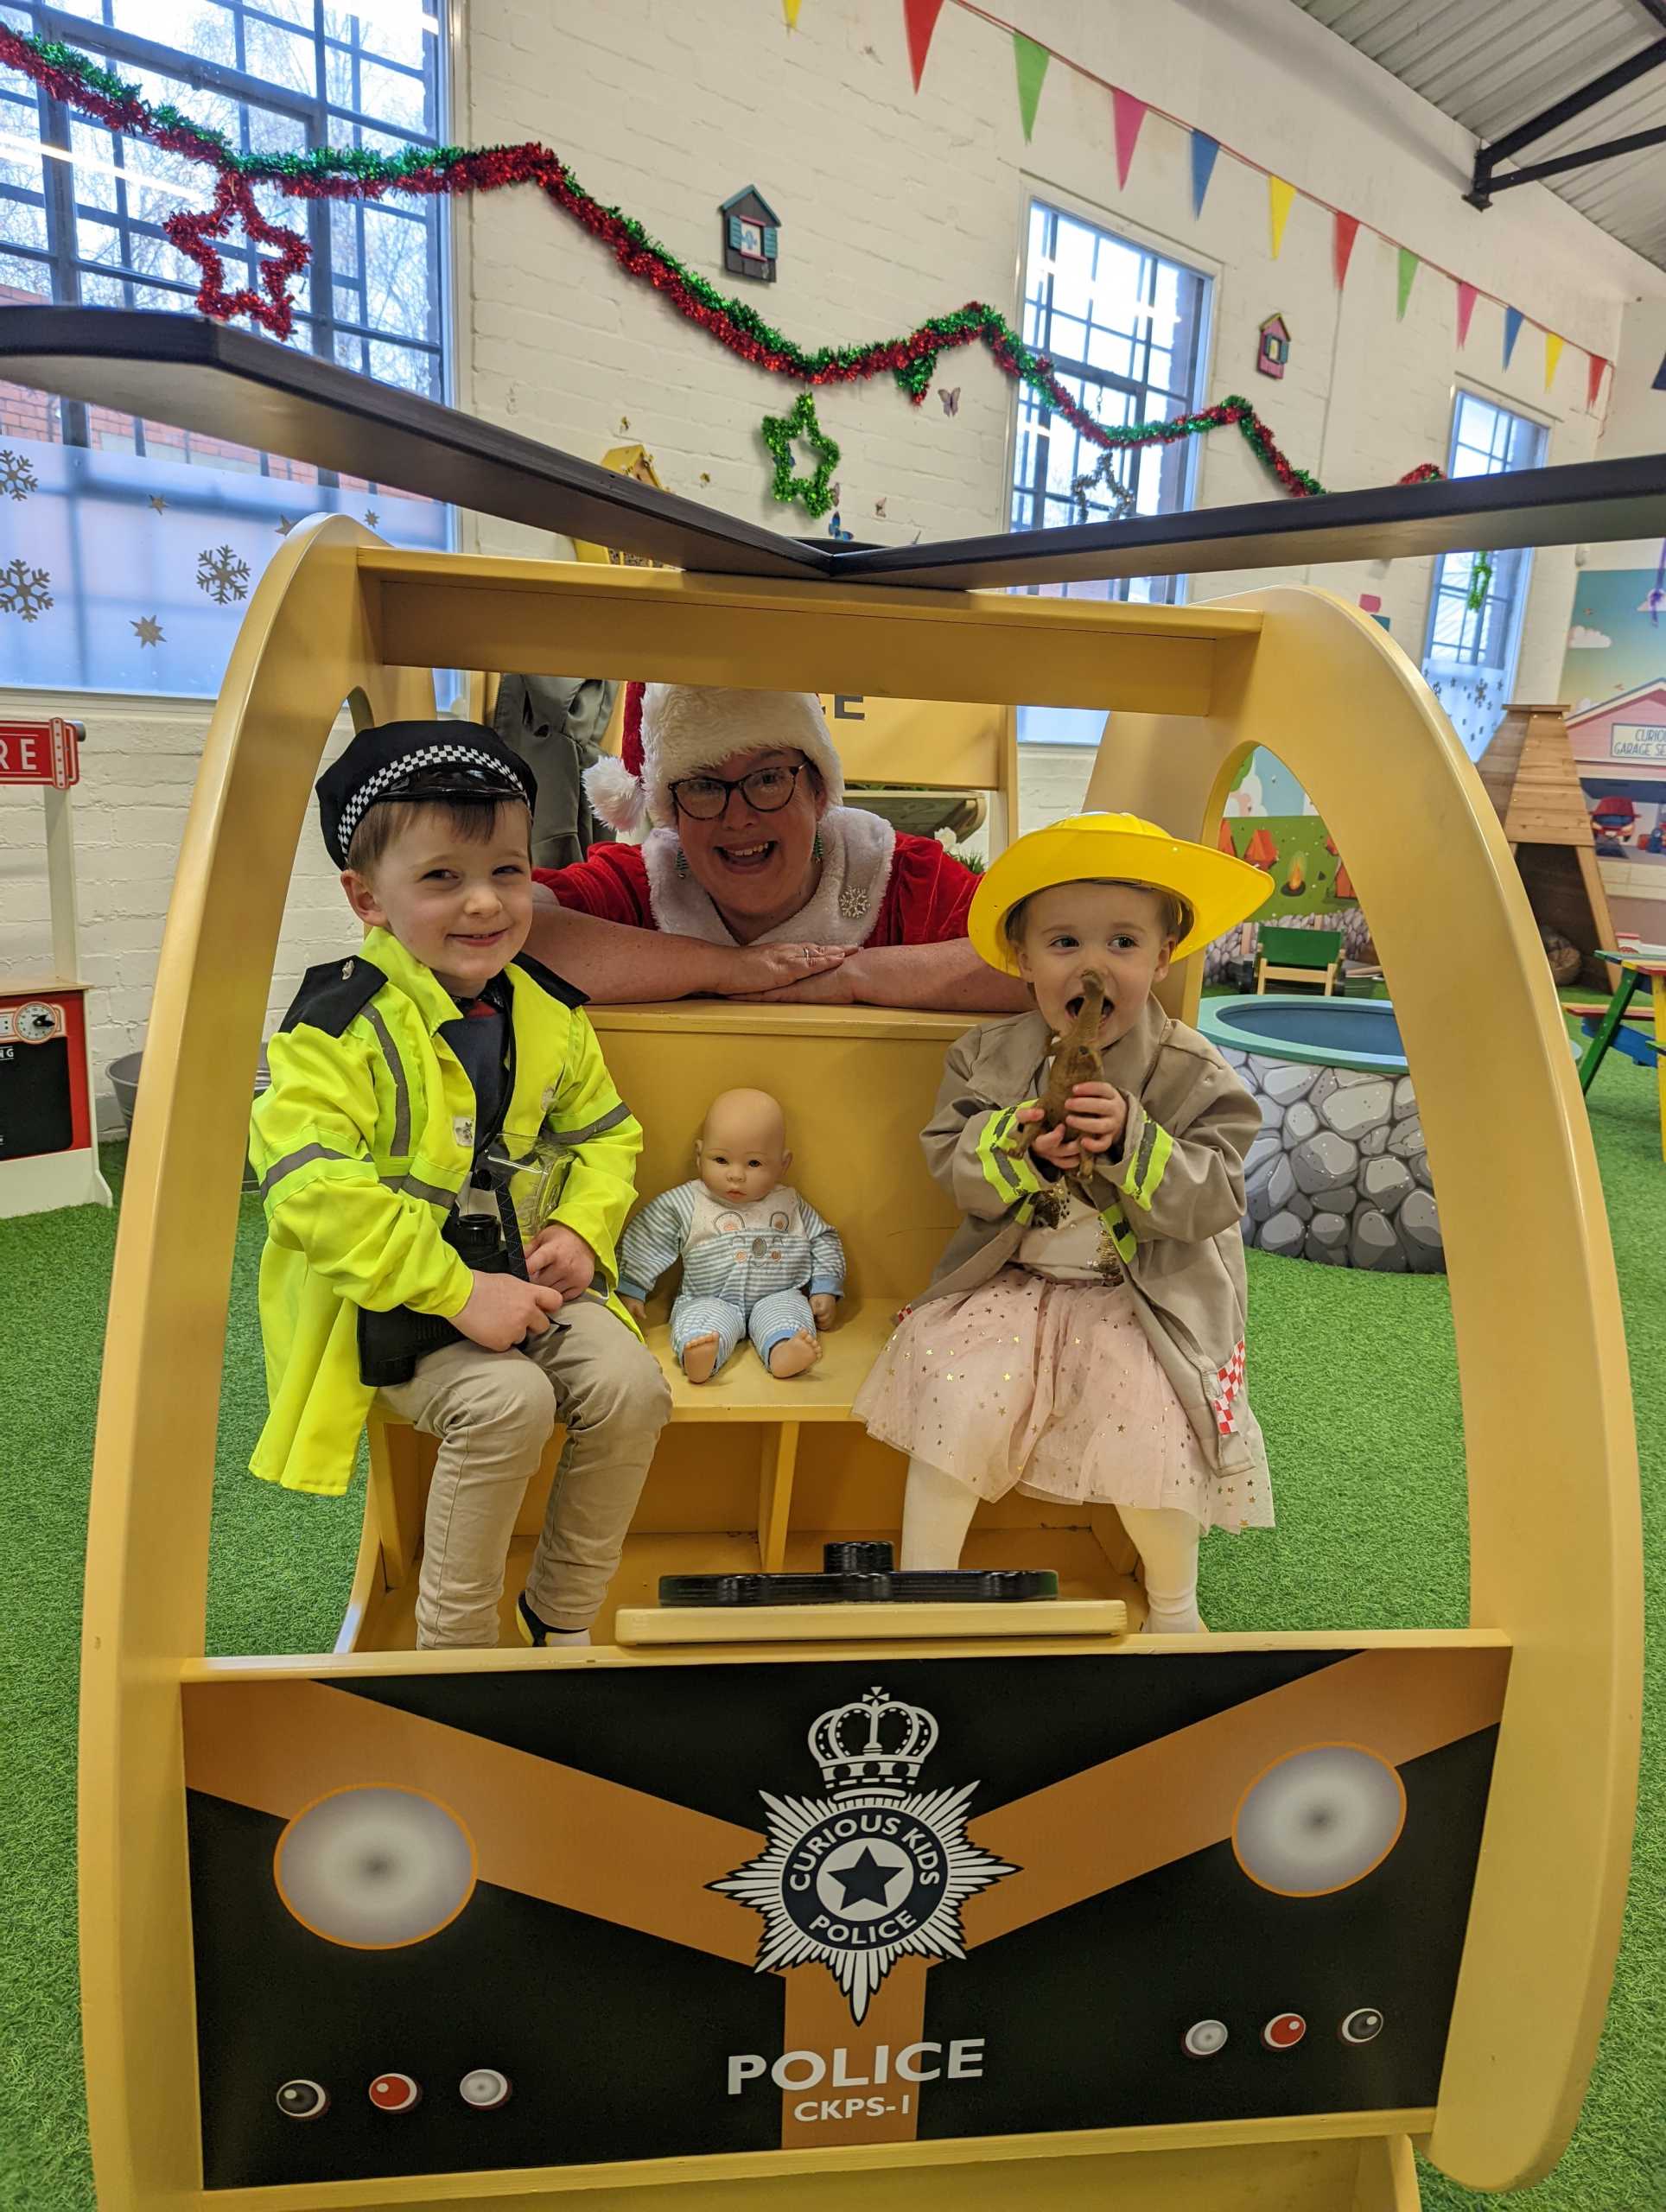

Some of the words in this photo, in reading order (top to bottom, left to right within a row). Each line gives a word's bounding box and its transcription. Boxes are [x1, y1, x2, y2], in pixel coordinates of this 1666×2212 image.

[1614, 742, 1652, 756] GARAGE
[789, 1815, 901, 1891] CURIOUS
[901, 1827, 940, 1885] KIDS
[808, 1910, 918, 1944] POLICE
[728, 2038, 985, 2094] POLICE
